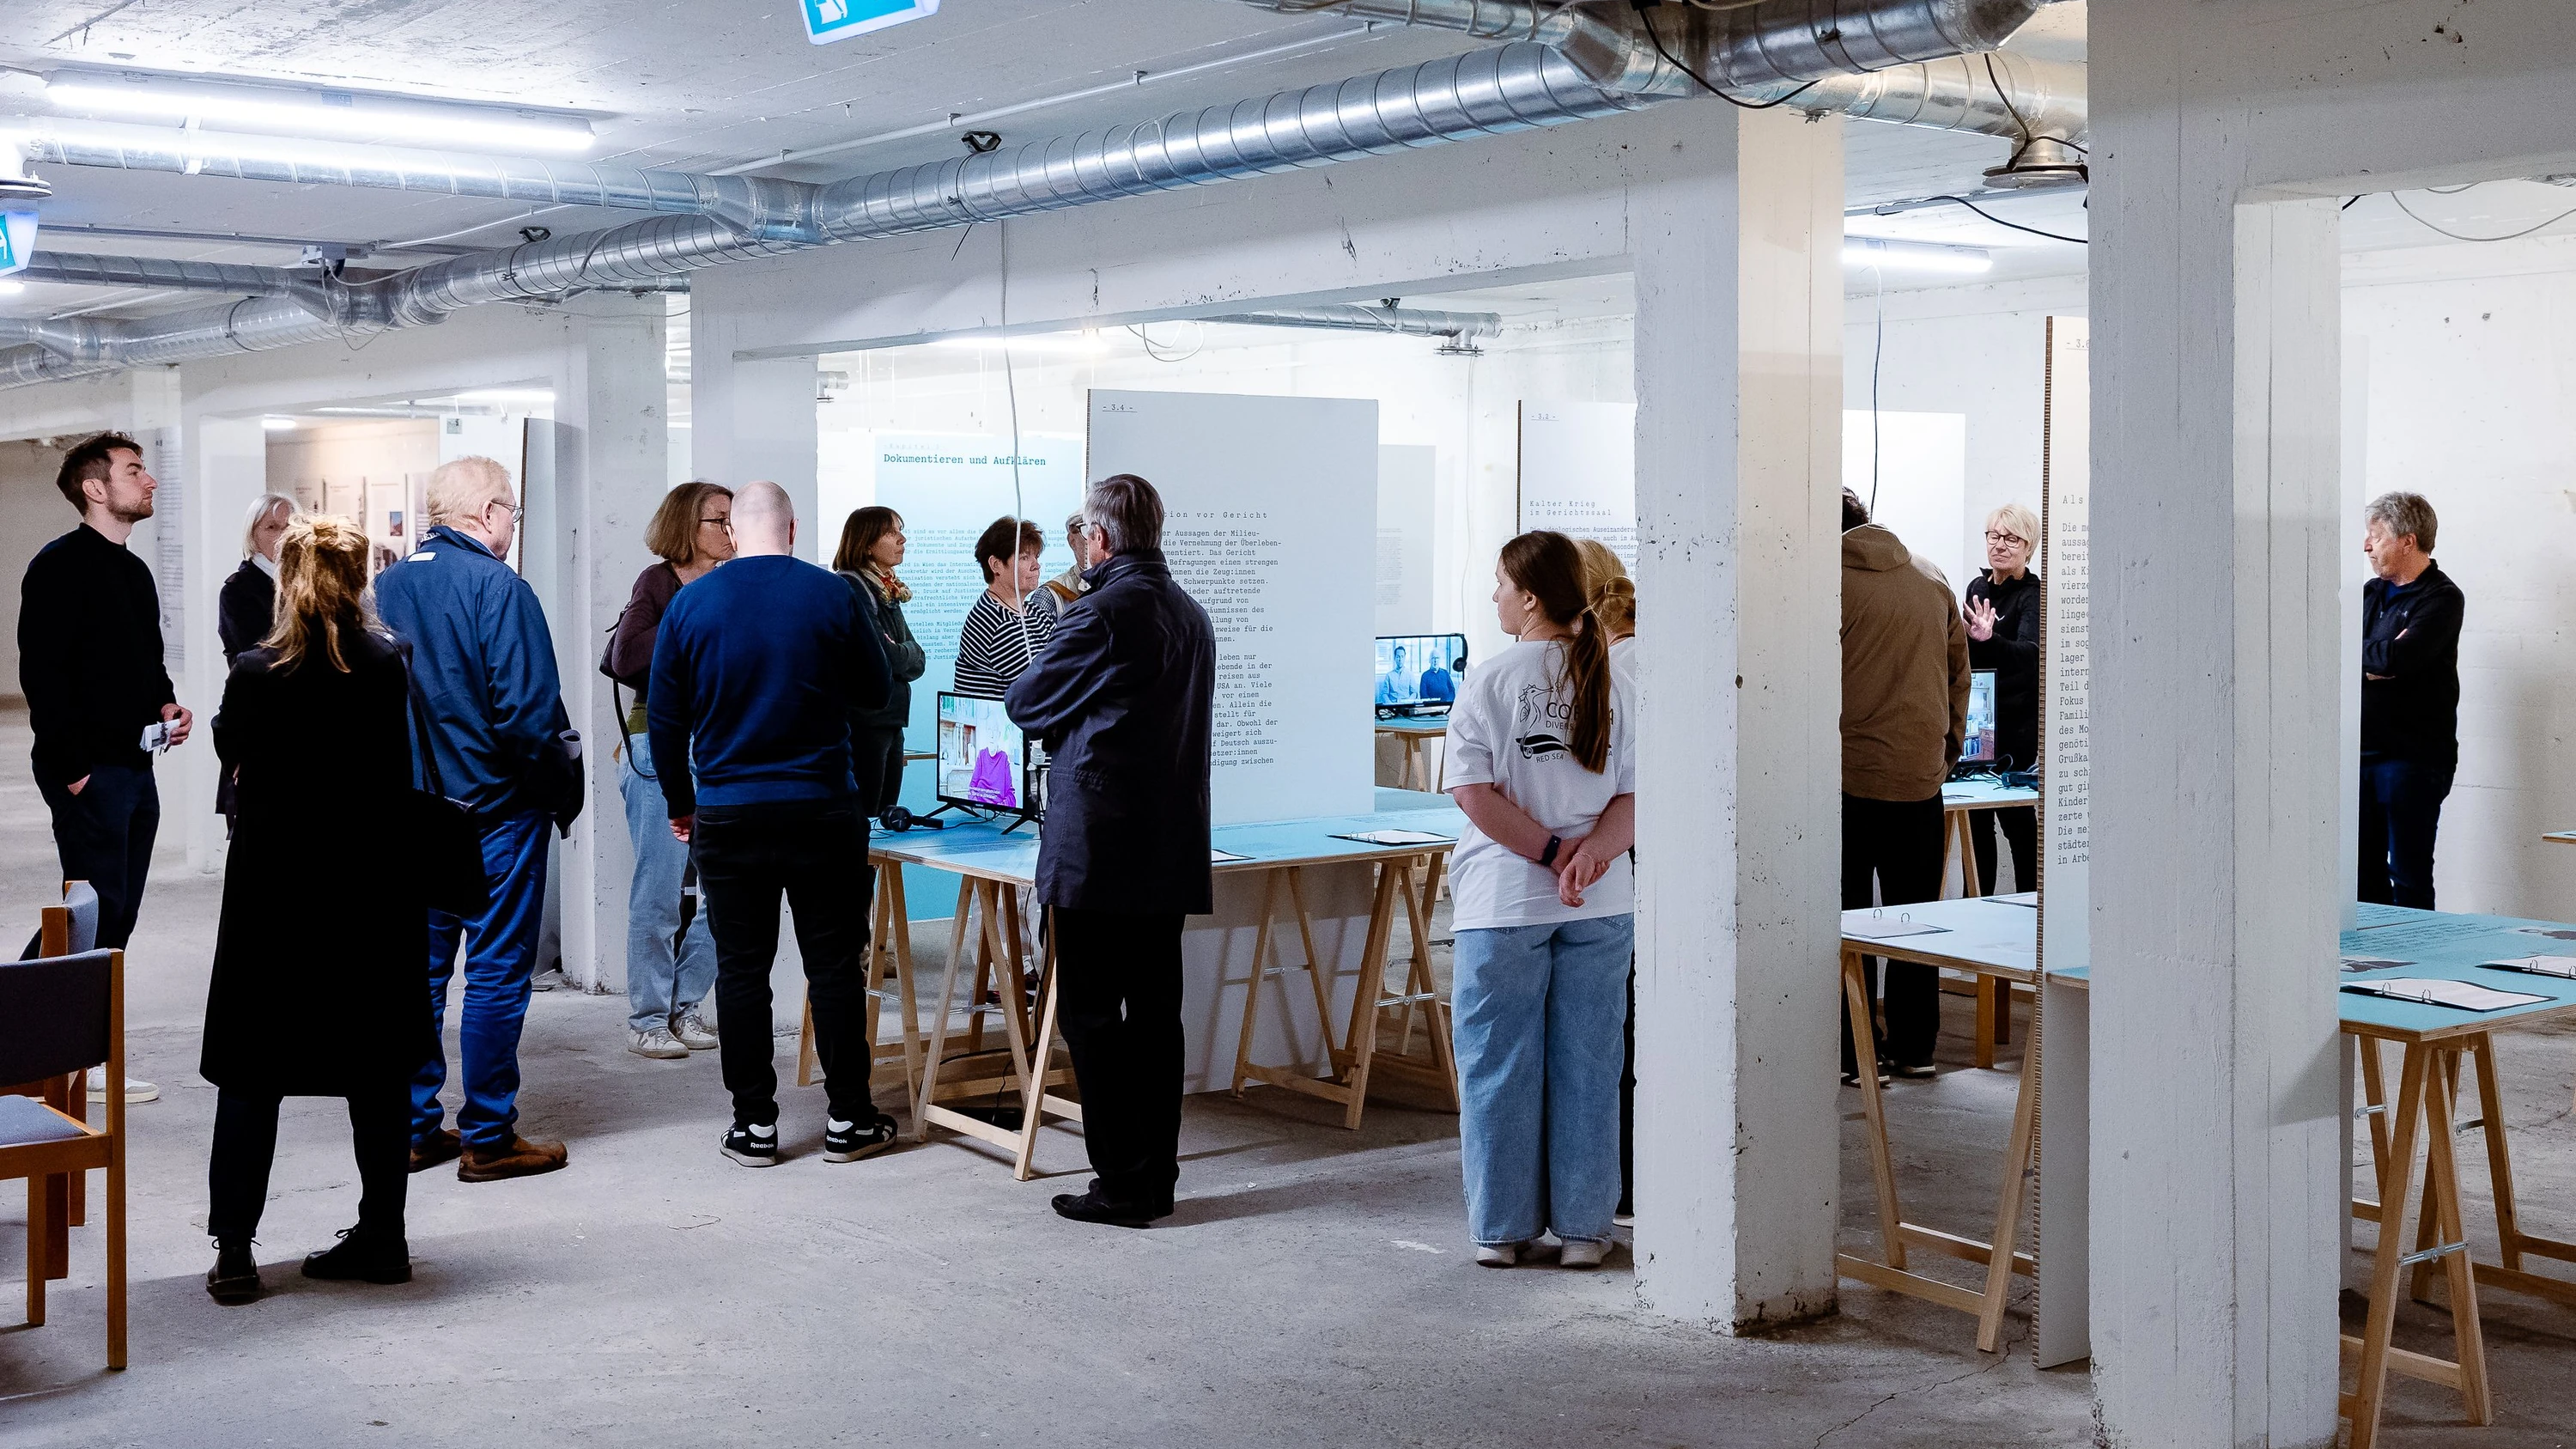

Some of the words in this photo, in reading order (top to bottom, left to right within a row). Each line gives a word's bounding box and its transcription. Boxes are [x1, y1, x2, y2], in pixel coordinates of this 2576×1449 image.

[884, 454, 963, 464] Dokumentieren
[969, 455, 987, 465] und
[993, 456, 1047, 466] Aufklären
[2063, 494, 2084, 504] Als
[2062, 522, 2077, 533] Die
[1175, 530, 1210, 539] Aussagen
[1179, 539, 1221, 548] Vernehmung
[2061, 566, 2076, 575] als
[1183, 578, 1235, 587] Schwerpunkte
[1199, 597, 1232, 606] aufgrund
[1211, 616, 1232, 624] llung
[2060, 638, 2070, 648] im
[2060, 653, 2085, 664] lager
[2059, 680, 2079, 691] Teil
[2059, 696, 2084, 706] Fokus
[2059, 709, 2089, 721] Famili
[1212, 730, 1242, 739] weigert
[2058, 725, 2074, 735] des
[2078, 724, 2089, 734] Mo
[2058, 738, 2088, 752] genöti
[1212, 748, 1258, 757] etzer:innen
[1212, 758, 1237, 768] digung
[2058, 752, 2088, 764] Grußka
[2058, 770, 2069, 778] zu
[2073, 767, 2090, 778] sch
[2057, 783, 2073, 795] gut
[2057, 795, 2089, 807] Kinder
[2058, 812, 2083, 821] zerte
[2057, 825, 2073, 836] Die
[2057, 855, 2068, 865] in
[826, 1135, 848, 1144] Reebok
